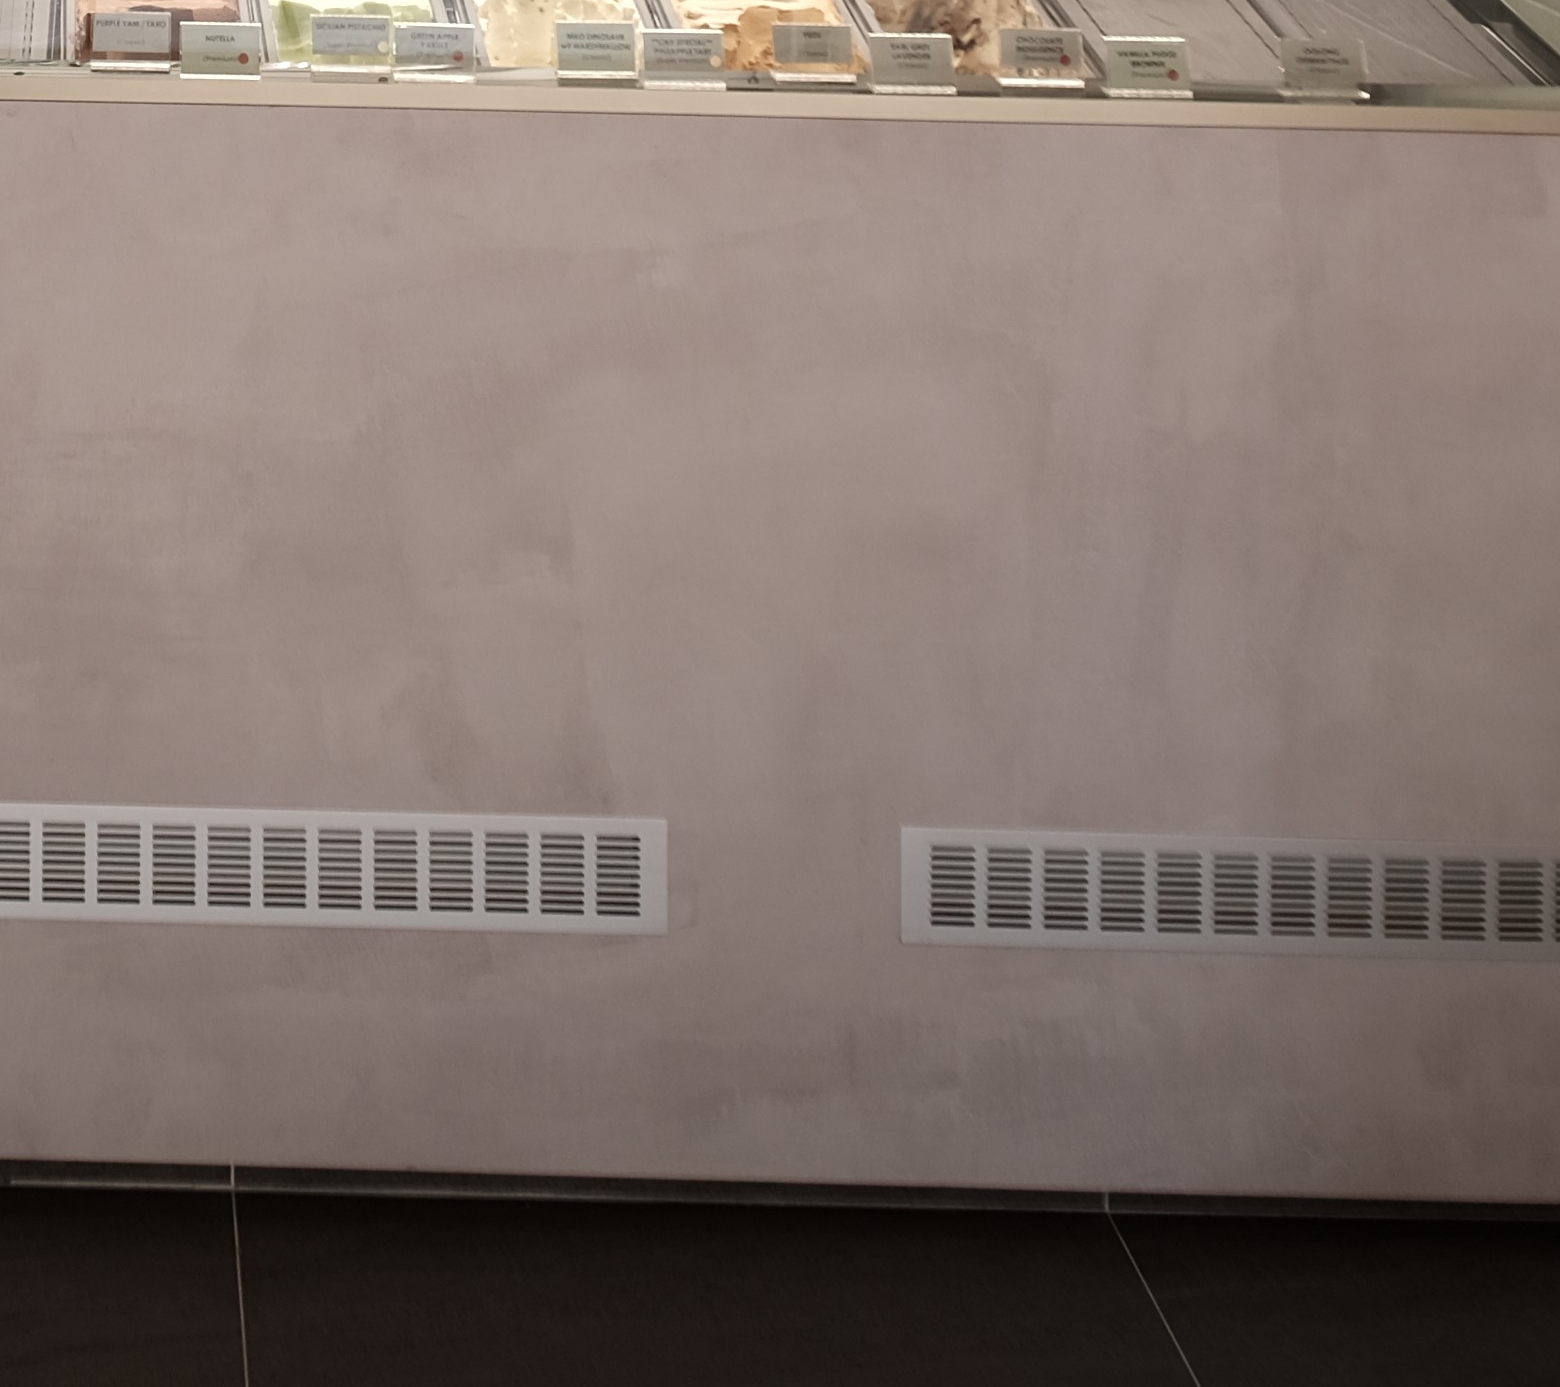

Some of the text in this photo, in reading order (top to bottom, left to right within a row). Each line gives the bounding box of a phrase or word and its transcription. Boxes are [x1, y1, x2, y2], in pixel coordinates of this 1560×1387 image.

[95, 19, 121, 28] PURPLE
[122, 19, 140, 28] YAM
[145, 20, 167, 28] TARO
[315, 23, 387, 32] SICILIAN PISTACHIO
[205, 34, 236, 43] NUTELLA
[410, 32, 435, 41] GREEN
[586, 33, 625, 41] DINOSAUR
